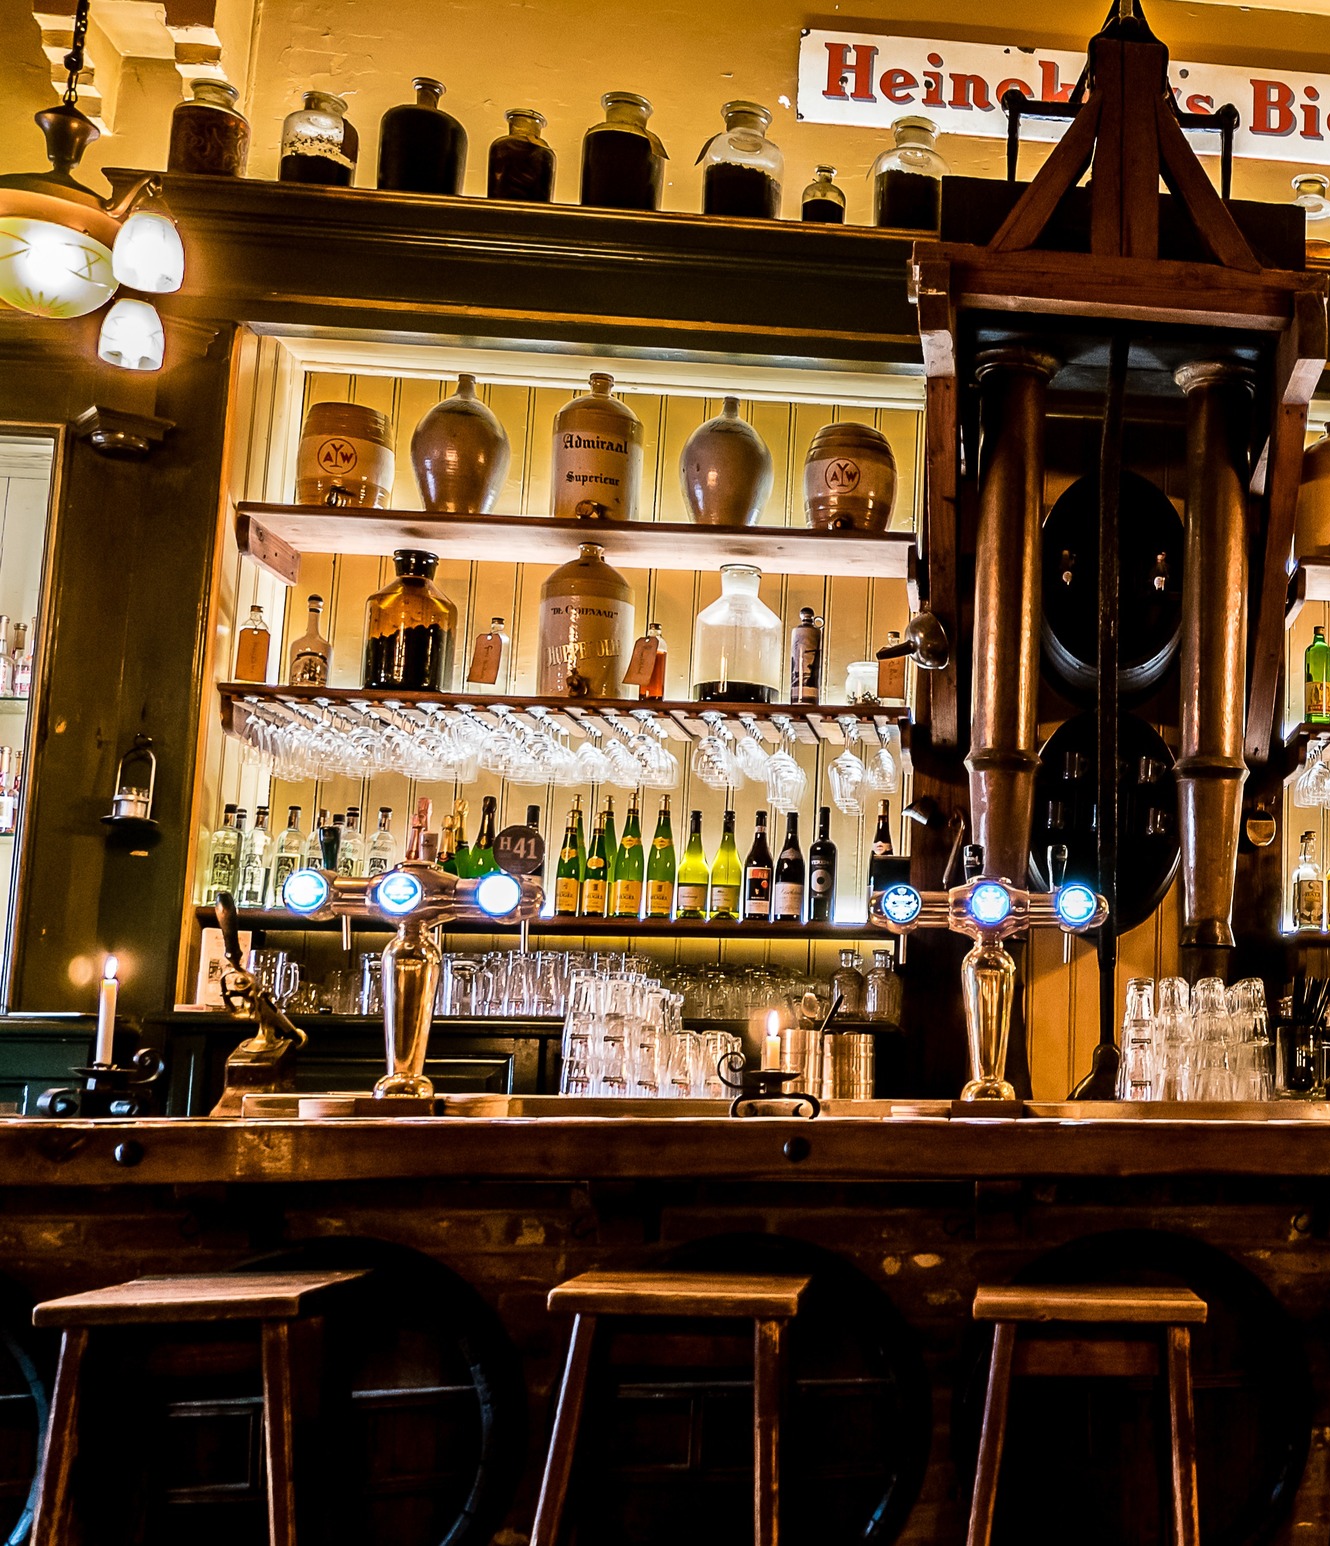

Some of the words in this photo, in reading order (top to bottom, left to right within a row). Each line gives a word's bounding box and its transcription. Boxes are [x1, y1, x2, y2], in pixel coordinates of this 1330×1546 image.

[821, 42, 1215, 116] Heineks
[563, 433, 629, 455] Admiraal
[566, 470, 620, 486] Superieur
[500, 837, 537, 859] H41
